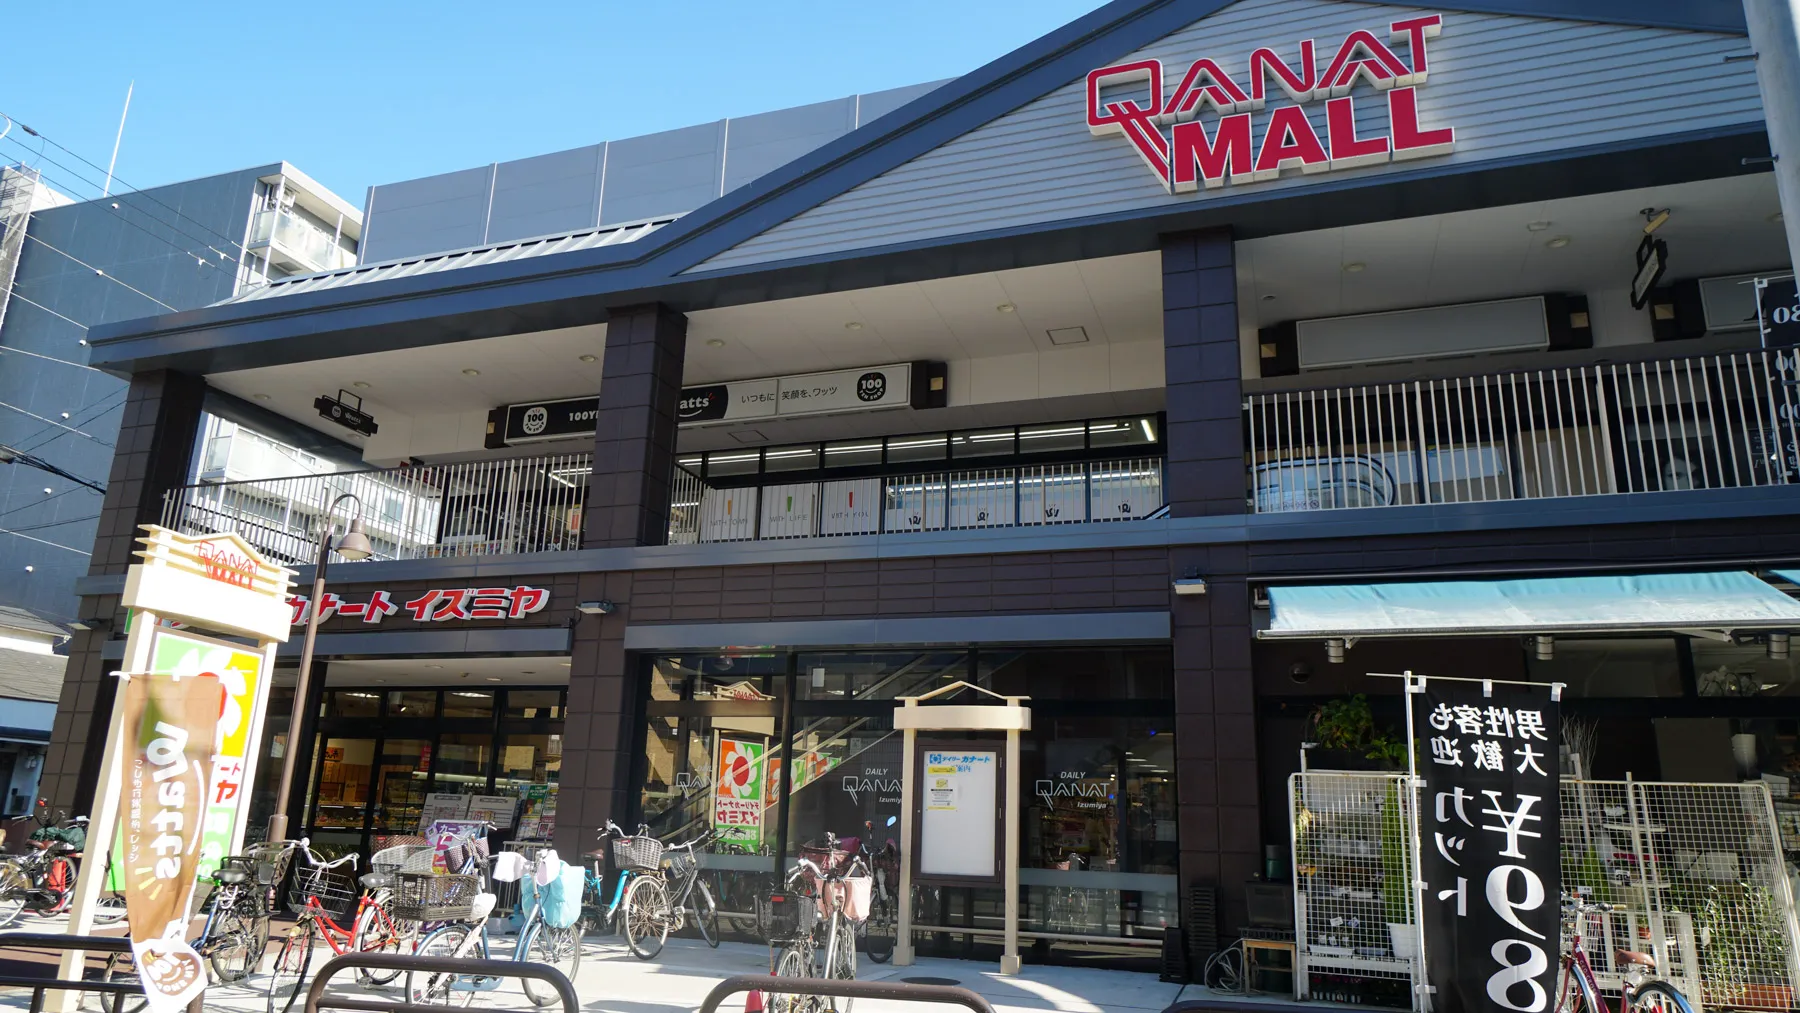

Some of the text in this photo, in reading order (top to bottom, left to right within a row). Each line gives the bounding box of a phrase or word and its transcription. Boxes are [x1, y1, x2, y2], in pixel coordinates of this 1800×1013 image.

[1086, 13, 1443, 195] QANAT
[1172, 86, 1455, 194] MALL
[861, 378, 883, 389] 100
[679, 396, 710, 410] atts
[527, 413, 545, 423] 100
[406, 586, 550, 622] イズミヤ
[1060, 771, 1086, 779] DAILY
[842, 775, 903, 806] QANA
[1035, 779, 1111, 811] QANAT
[878, 796, 903, 804] Izumiy
[1077, 801, 1107, 810] Izumiya
